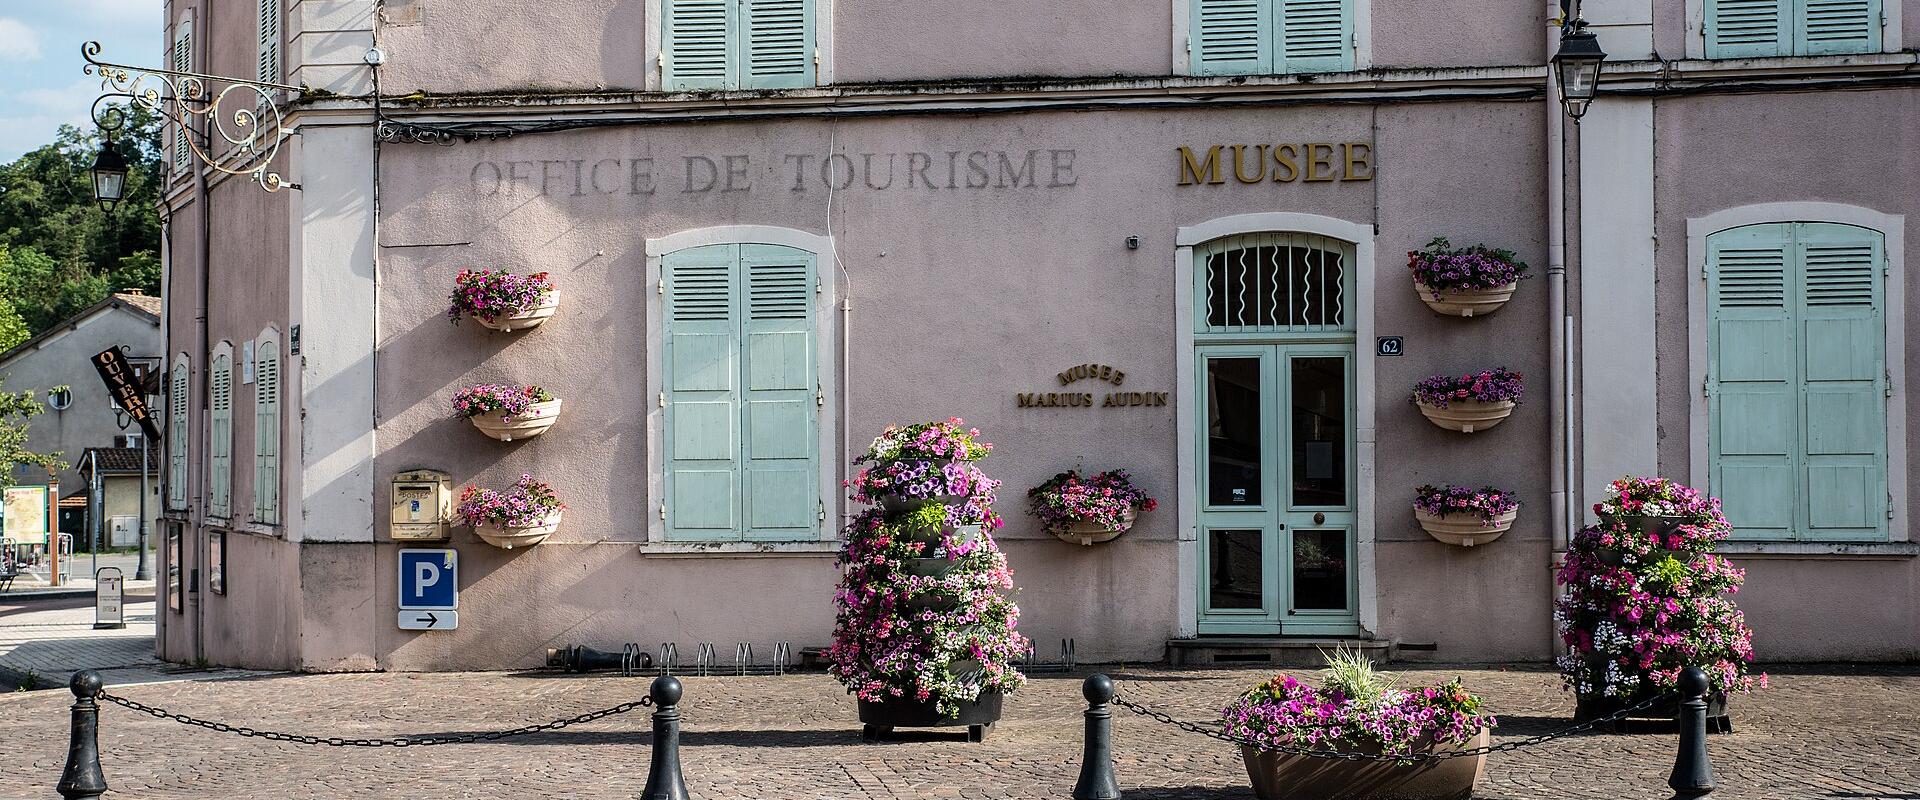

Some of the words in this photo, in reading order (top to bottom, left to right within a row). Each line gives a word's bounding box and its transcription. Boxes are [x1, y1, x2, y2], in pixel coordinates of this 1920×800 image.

[470, 157, 656, 197] OFFICE
[680, 155, 751, 194] DE
[784, 149, 1079, 193] TOURISME
[1177, 142, 1376, 186] MUSEE
[1382, 340, 1398, 353] 62
[100, 351, 146, 420] OUVERT
[1057, 363, 1126, 387] MUSEE
[1017, 392, 1094, 409] MARIUS
[1102, 391, 1169, 408] AUDIN
[402, 491, 429, 499] POSTES
[415, 561, 440, 598] P
